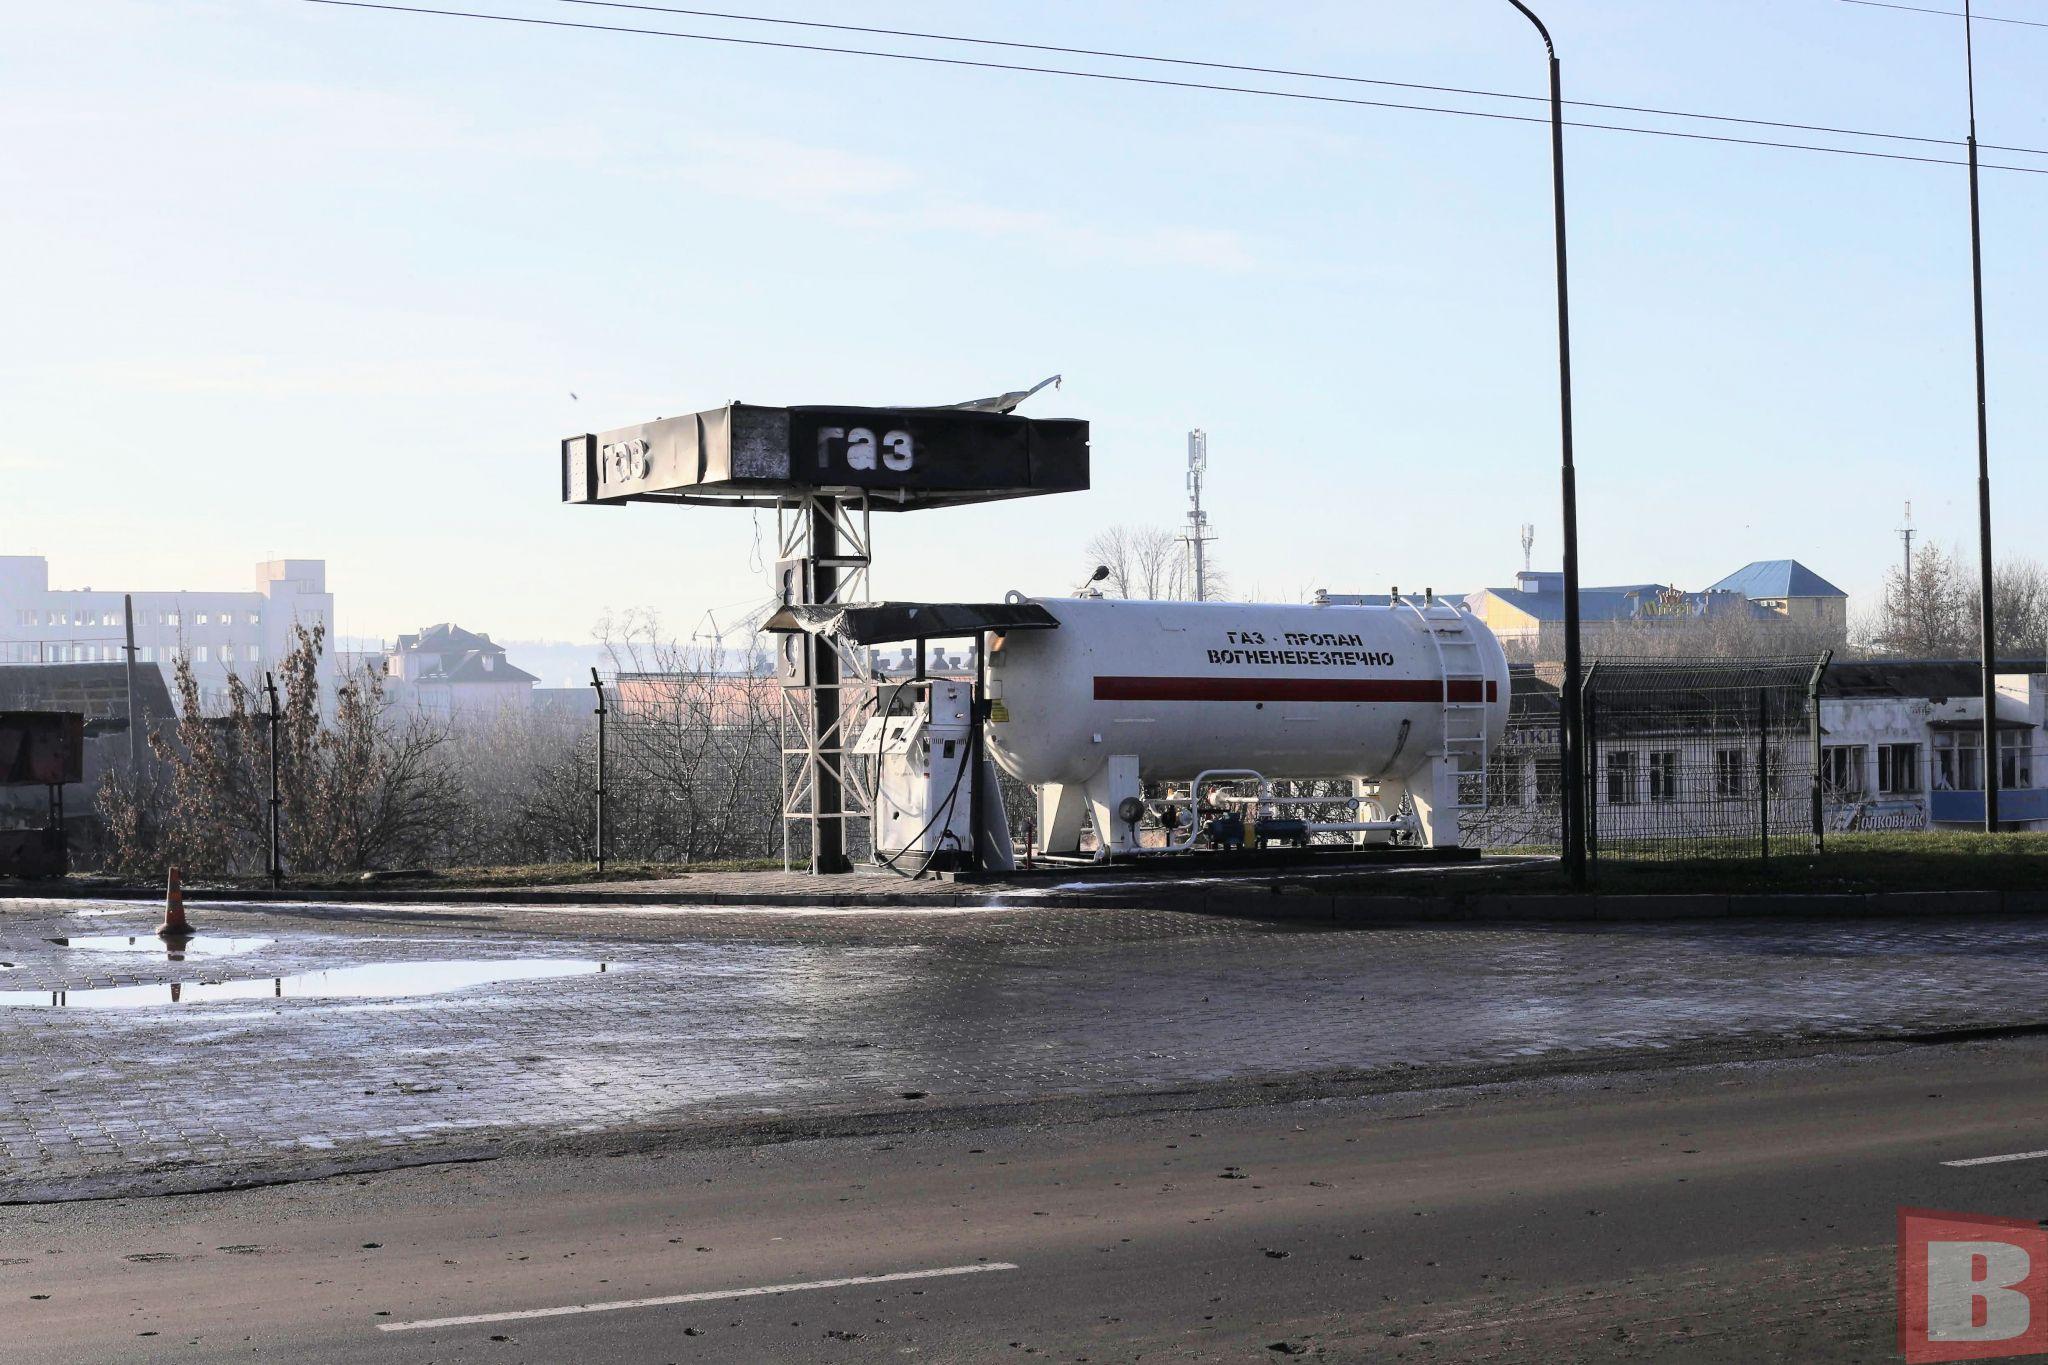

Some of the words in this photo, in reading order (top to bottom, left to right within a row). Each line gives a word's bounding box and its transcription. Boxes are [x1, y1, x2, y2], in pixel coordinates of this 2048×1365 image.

[817, 426, 914, 472] газ
[1226, 631, 1265, 645] ГАЗ
[1285, 633, 1363, 647] ПРОПАН
[1206, 649, 1395, 666] ВОГНЕНЕБЕЗПЕЧНО
